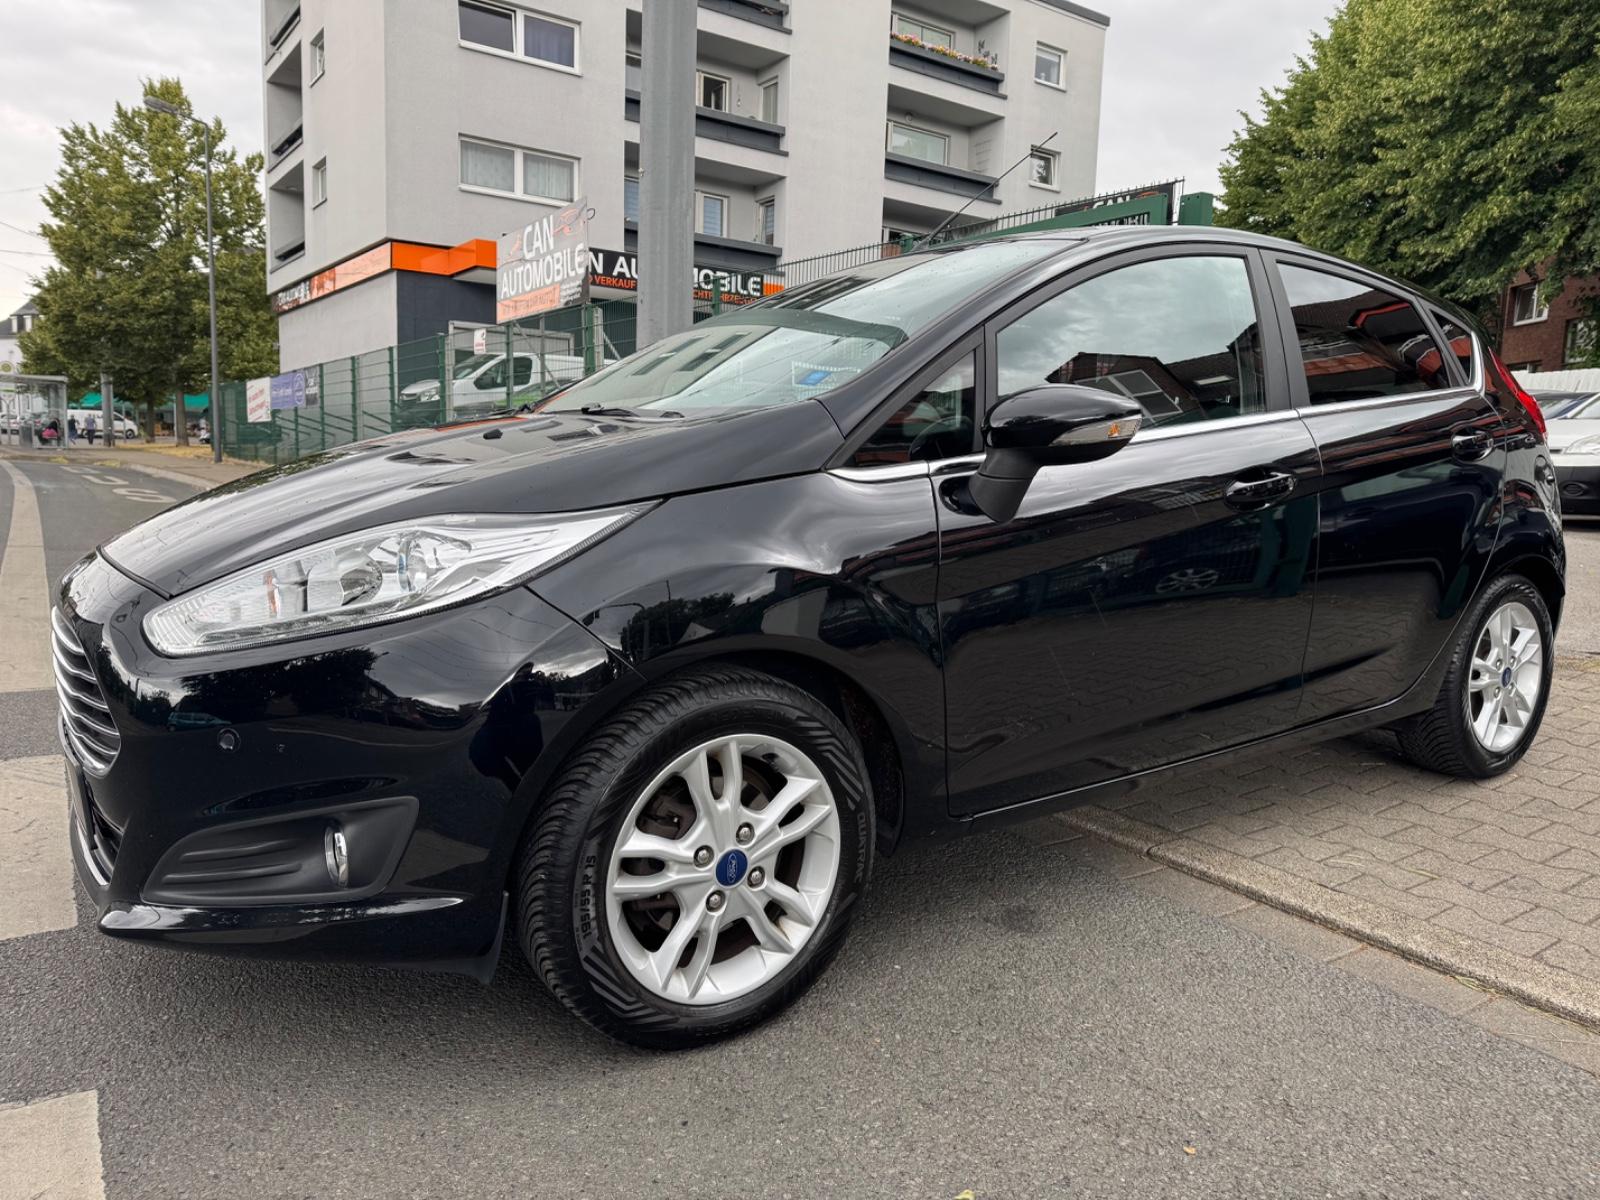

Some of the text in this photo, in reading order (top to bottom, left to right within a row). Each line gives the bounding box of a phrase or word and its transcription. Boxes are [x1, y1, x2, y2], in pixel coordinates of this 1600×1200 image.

[523, 214, 554, 259] CAN
[501, 243, 585, 299] AUTOMOBILE
[594, 274, 637, 289] VERKAUF
